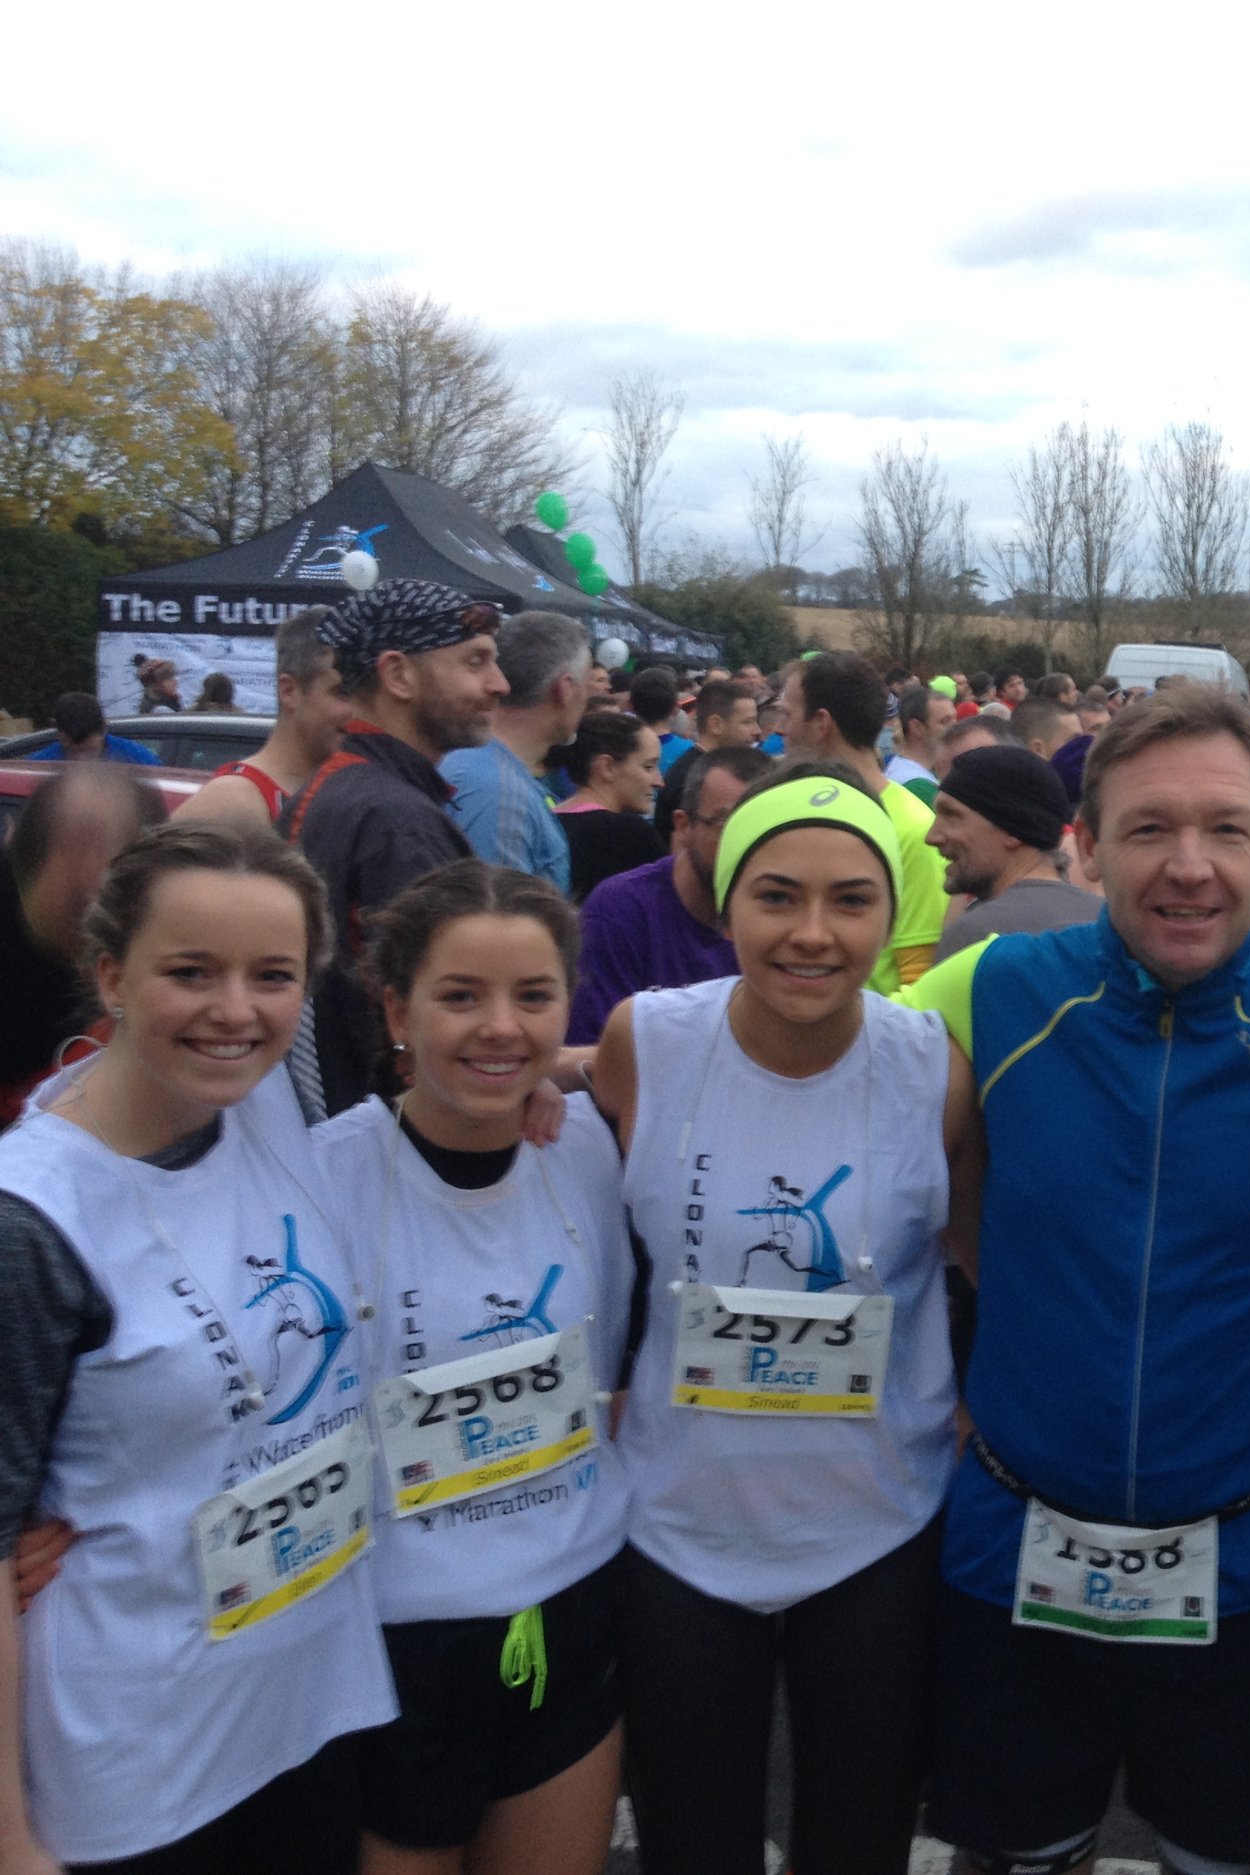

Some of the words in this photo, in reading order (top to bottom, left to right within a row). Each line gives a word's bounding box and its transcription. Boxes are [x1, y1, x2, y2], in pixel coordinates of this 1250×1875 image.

[102, 592, 183, 623] The
[684, 1153, 712, 1284] CLONA
[712, 1304, 858, 1346] 2573
[749, 1346, 819, 1386] PEACE
[412, 1353, 564, 1429] 2568
[462, 1415, 541, 1461] PEACE
[448, 1483, 571, 1528] Marathon
